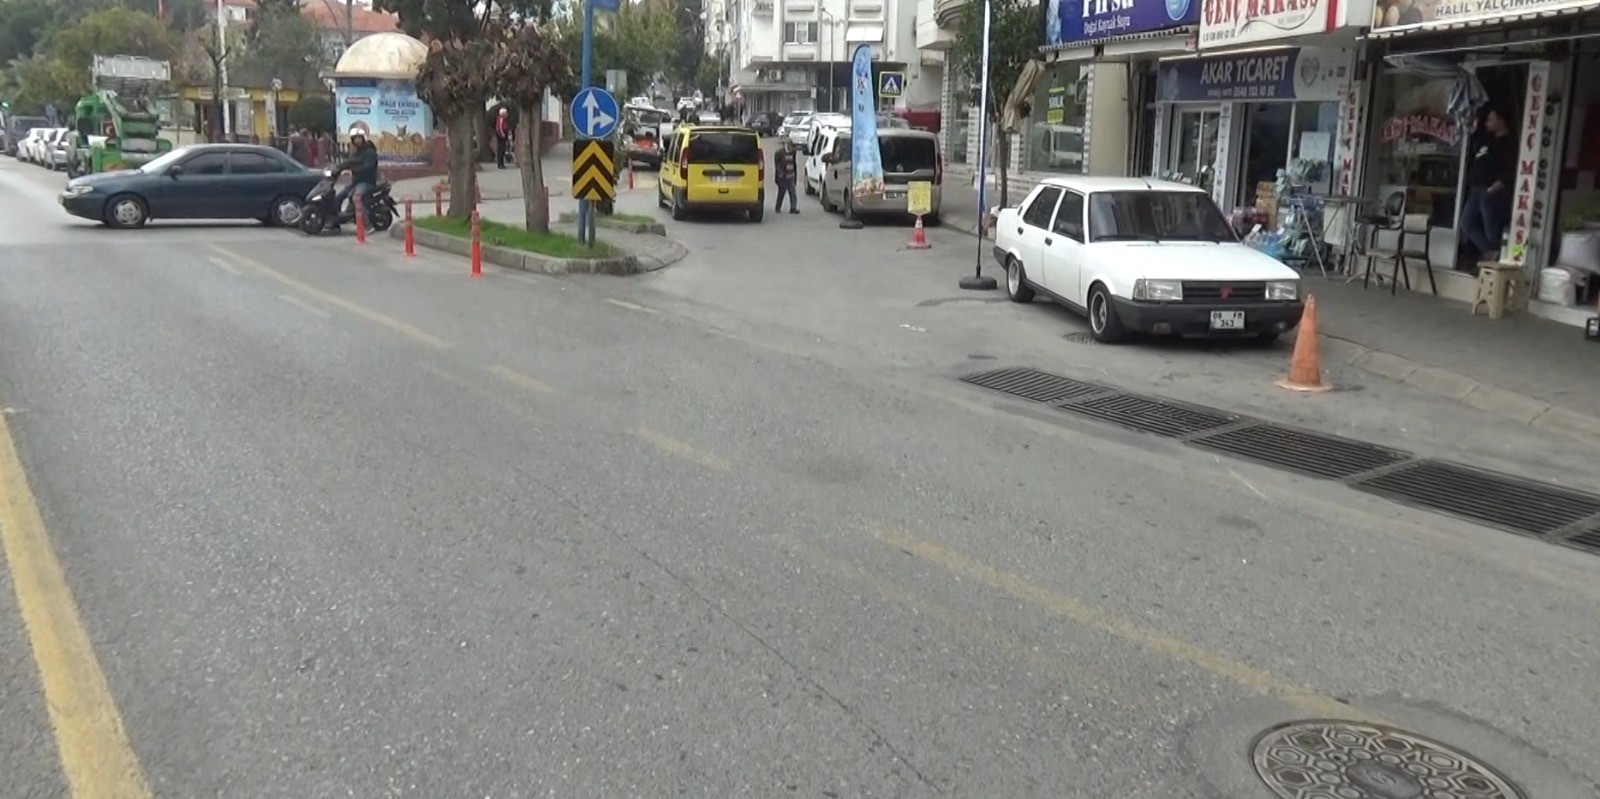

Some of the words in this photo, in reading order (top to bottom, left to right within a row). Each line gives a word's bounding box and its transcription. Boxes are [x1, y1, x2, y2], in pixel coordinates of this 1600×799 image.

[1204, 0, 1241, 27] GENÇ
[1200, 60, 1233, 84] AKAR
[1236, 56, 1288, 82] TİCARET
[1526, 74, 1542, 151] GENÇ
[1515, 160, 1536, 245] MAKAS
